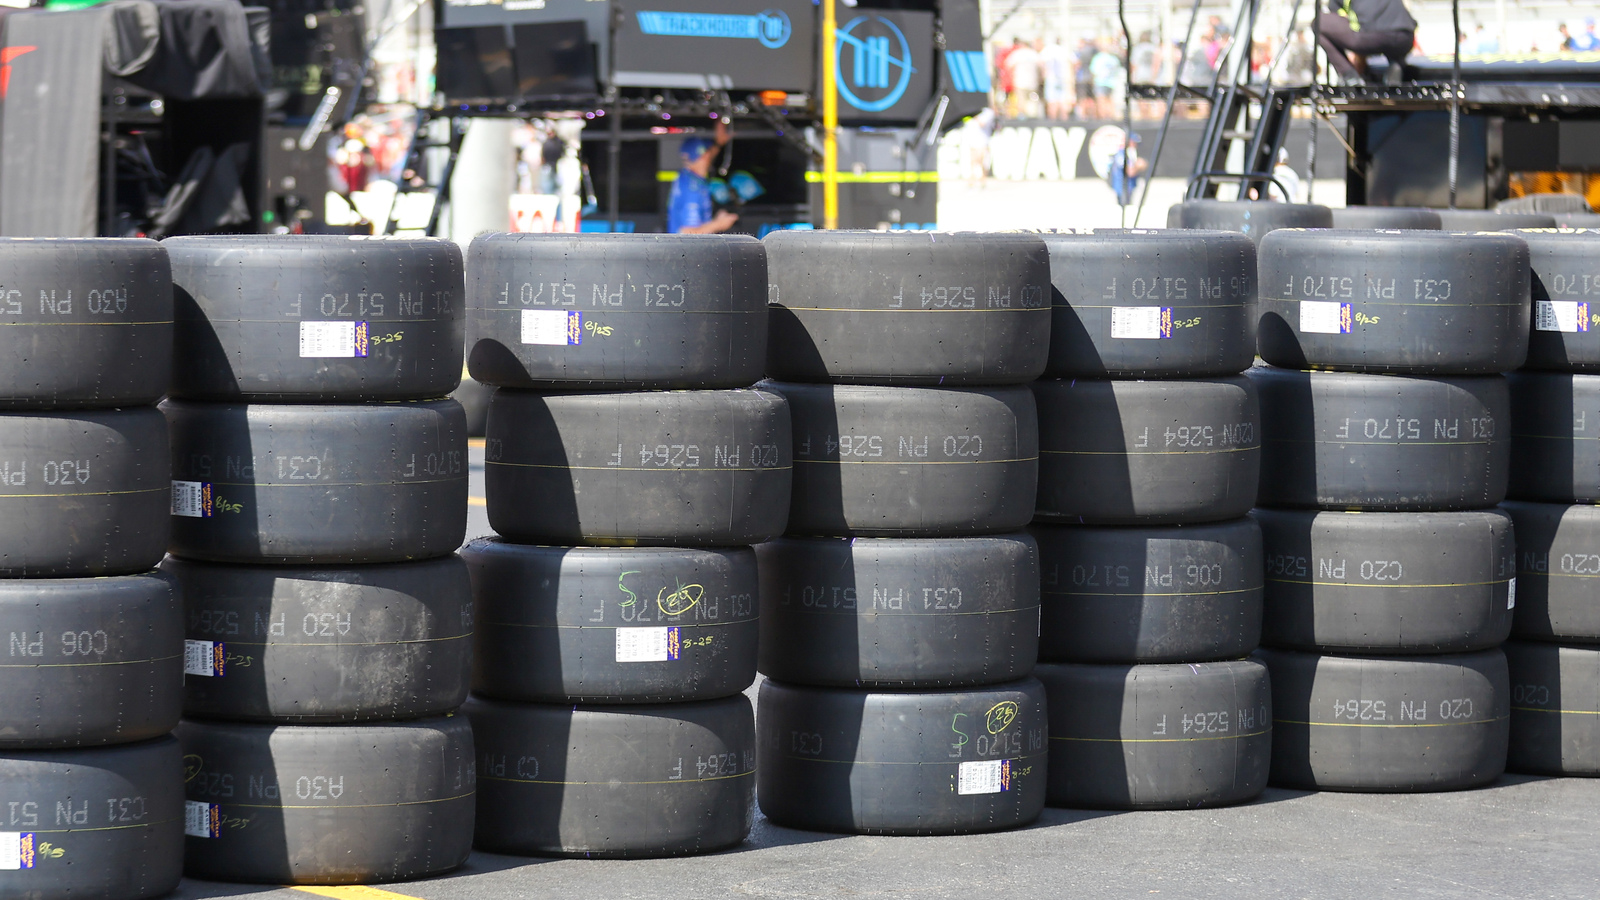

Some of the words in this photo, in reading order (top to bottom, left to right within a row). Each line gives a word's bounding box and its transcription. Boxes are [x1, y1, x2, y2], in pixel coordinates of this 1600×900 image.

[497, 282, 509, 305] F
[520, 282, 576, 306] 5170
[592, 283, 624, 306] PN
[643, 283, 685, 307] C31
[888, 286, 903, 308] F
[919, 286, 976, 308] 5264
[988, 286, 1011, 308] PN
[1021, 285, 1043, 308] C20
[1102, 277, 1117, 299] F
[1132, 277, 1187, 299] 5170
[1200, 276, 1221, 299] PN
[1283, 275, 1294, 296] F
[1303, 276, 1353, 298] 5170
[1366, 278, 1396, 299] PN
[1413, 278, 1451, 300] C31
[39, 289, 72, 315] PN
[87, 288, 127, 314] A30
[285, 293, 302, 317] F
[320, 292, 385, 317] 5170
[399, 291, 424, 316] PN
[435, 290, 454, 315] 31
[584, 321, 614, 338] 8/25
[1173, 317, 1201, 330] 8-25
[370, 331, 404, 346] 8-25
[1335, 418, 1350, 439] F
[1364, 418, 1420, 439] 5170
[1434, 418, 1459, 439] PN
[1471, 417, 1495, 438] C31
[1574, 411, 1586, 432] F
[799, 435, 811, 455] F
[825, 435, 884, 457] 5264
[899, 435, 928, 457] PN
[942, 435, 983, 457] C20
[1134, 426, 1148, 448] F
[1163, 425, 1213, 447] 5264
[403, 454, 415, 478] F
[427, 451, 460, 476] 5170
[607, 443, 623, 466] F
[638, 444, 700, 467] 5264
[714, 444, 740, 468] PN
[750, 443, 779, 467] C20
[43, 459, 90, 485] A30
[226, 455, 257, 479] PN
[276, 456, 322, 480] C31
[1267, 555, 1307, 577] 5264
[1319, 557, 1346, 580] PN
[1360, 560, 1403, 581] C20
[1560, 553, 1600, 573] C20
[1072, 564, 1130, 587] 5170
[1145, 564, 1173, 587] PN
[1186, 564, 1222, 586] C06
[730, 593, 752, 618] C31
[802, 585, 857, 609] 5170
[873, 588, 903, 610] PN
[922, 587, 962, 610] C31
[588, 599, 605, 623] F
[695, 597, 719, 621] PN
[254, 611, 286, 637] PN
[303, 612, 351, 637] A30
[9, 631, 44, 657] PN
[61, 630, 108, 656] C06
[682, 635, 713, 649] 8-25
[1515, 684, 1549, 705] C20
[1238, 707, 1255, 730] PN
[1333, 698, 1386, 721] 5264
[1400, 699, 1427, 721] PN
[1439, 698, 1473, 719] C20
[1153, 714, 1167, 736] F
[1181, 711, 1229, 734] 5264
[791, 730, 822, 755] C31
[976, 733, 1021, 757] 5170
[669, 758, 682, 780] F
[696, 753, 737, 777] 5264
[249, 774, 280, 799] PN
[295, 775, 344, 799] A30
[0, 801, 38, 827] 51
[55, 800, 88, 825] PN
[106, 796, 147, 822] C31
